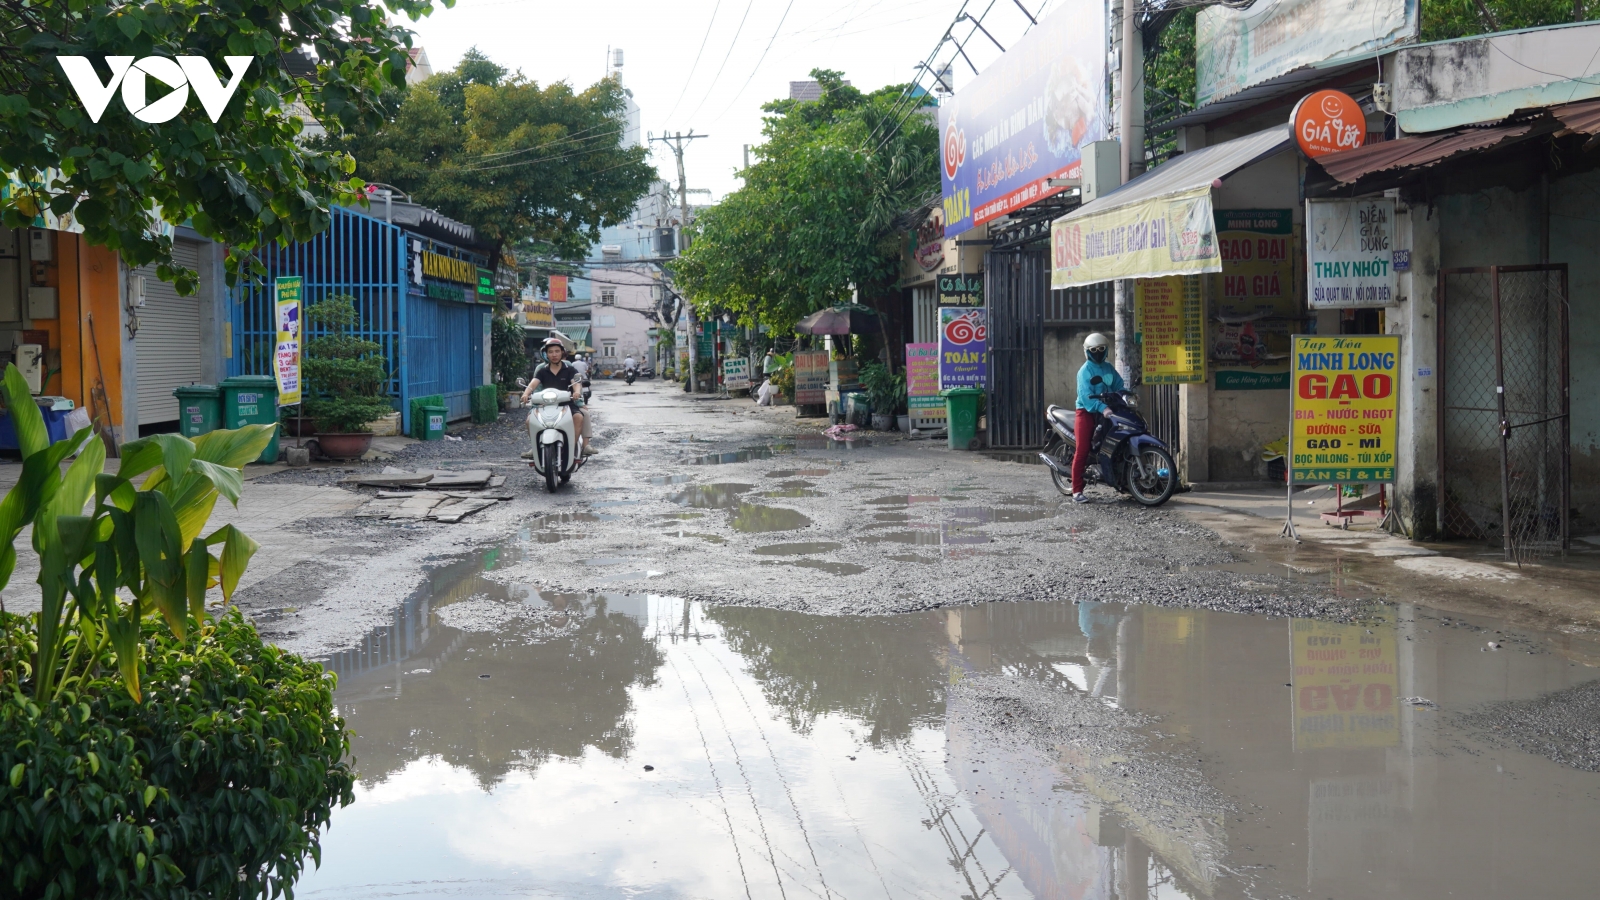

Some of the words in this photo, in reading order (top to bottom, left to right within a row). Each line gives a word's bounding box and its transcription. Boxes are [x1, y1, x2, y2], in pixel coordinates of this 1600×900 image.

[964, 186, 970, 218] 2
[1360, 204, 1387, 225] ĐIỆN
[1228, 220, 1251, 228] MINH
[1254, 220, 1278, 228] LONG
[1360, 226, 1379, 236] GIA
[1054, 224, 1082, 277] GẠO
[1085, 224, 1104, 259] ĐỒNG
[1106, 228, 1125, 260] LOẠT
[1127, 214, 1148, 252] GIẢM
[1151, 212, 1166, 249] GIÁ
[1219, 239, 1252, 265] GẠO
[1257, 239, 1286, 264] ĐẠI
[1361, 236, 1389, 253] DỤNG
[1394, 251, 1408, 263] 336
[1315, 261, 1350, 278] THAY
[1353, 256, 1389, 277] NHỚT
[1225, 275, 1247, 300] HẠ
[1253, 271, 1280, 296] GIÁ
[940, 293, 960, 305] Beauty
[961, 293, 966, 303] &
[1299, 338, 1326, 351] Tạp
[1333, 338, 1362, 349] Hóa
[1298, 353, 1343, 370] MINH
[1348, 353, 1395, 370] LONG
[1299, 374, 1392, 405] GẠO
[1295, 410, 1314, 419] BIA
[1327, 408, 1358, 419] NƯỚC
[1363, 409, 1393, 421] NGỌT
[1306, 423, 1346, 435] ĐƯỜNG
[1358, 423, 1381, 434] SỮA
[1307, 439, 1341, 451] GẠO
[1360, 437, 1381, 448] MÌ
[1295, 454, 1312, 466] BỌC
[1316, 454, 1348, 463] NILONG
[1357, 452, 1371, 463] TÚI
[1374, 450, 1392, 463] XỐP
[1294, 470, 1330, 480] BÁN
[1375, 468, 1391, 479] LẺ
